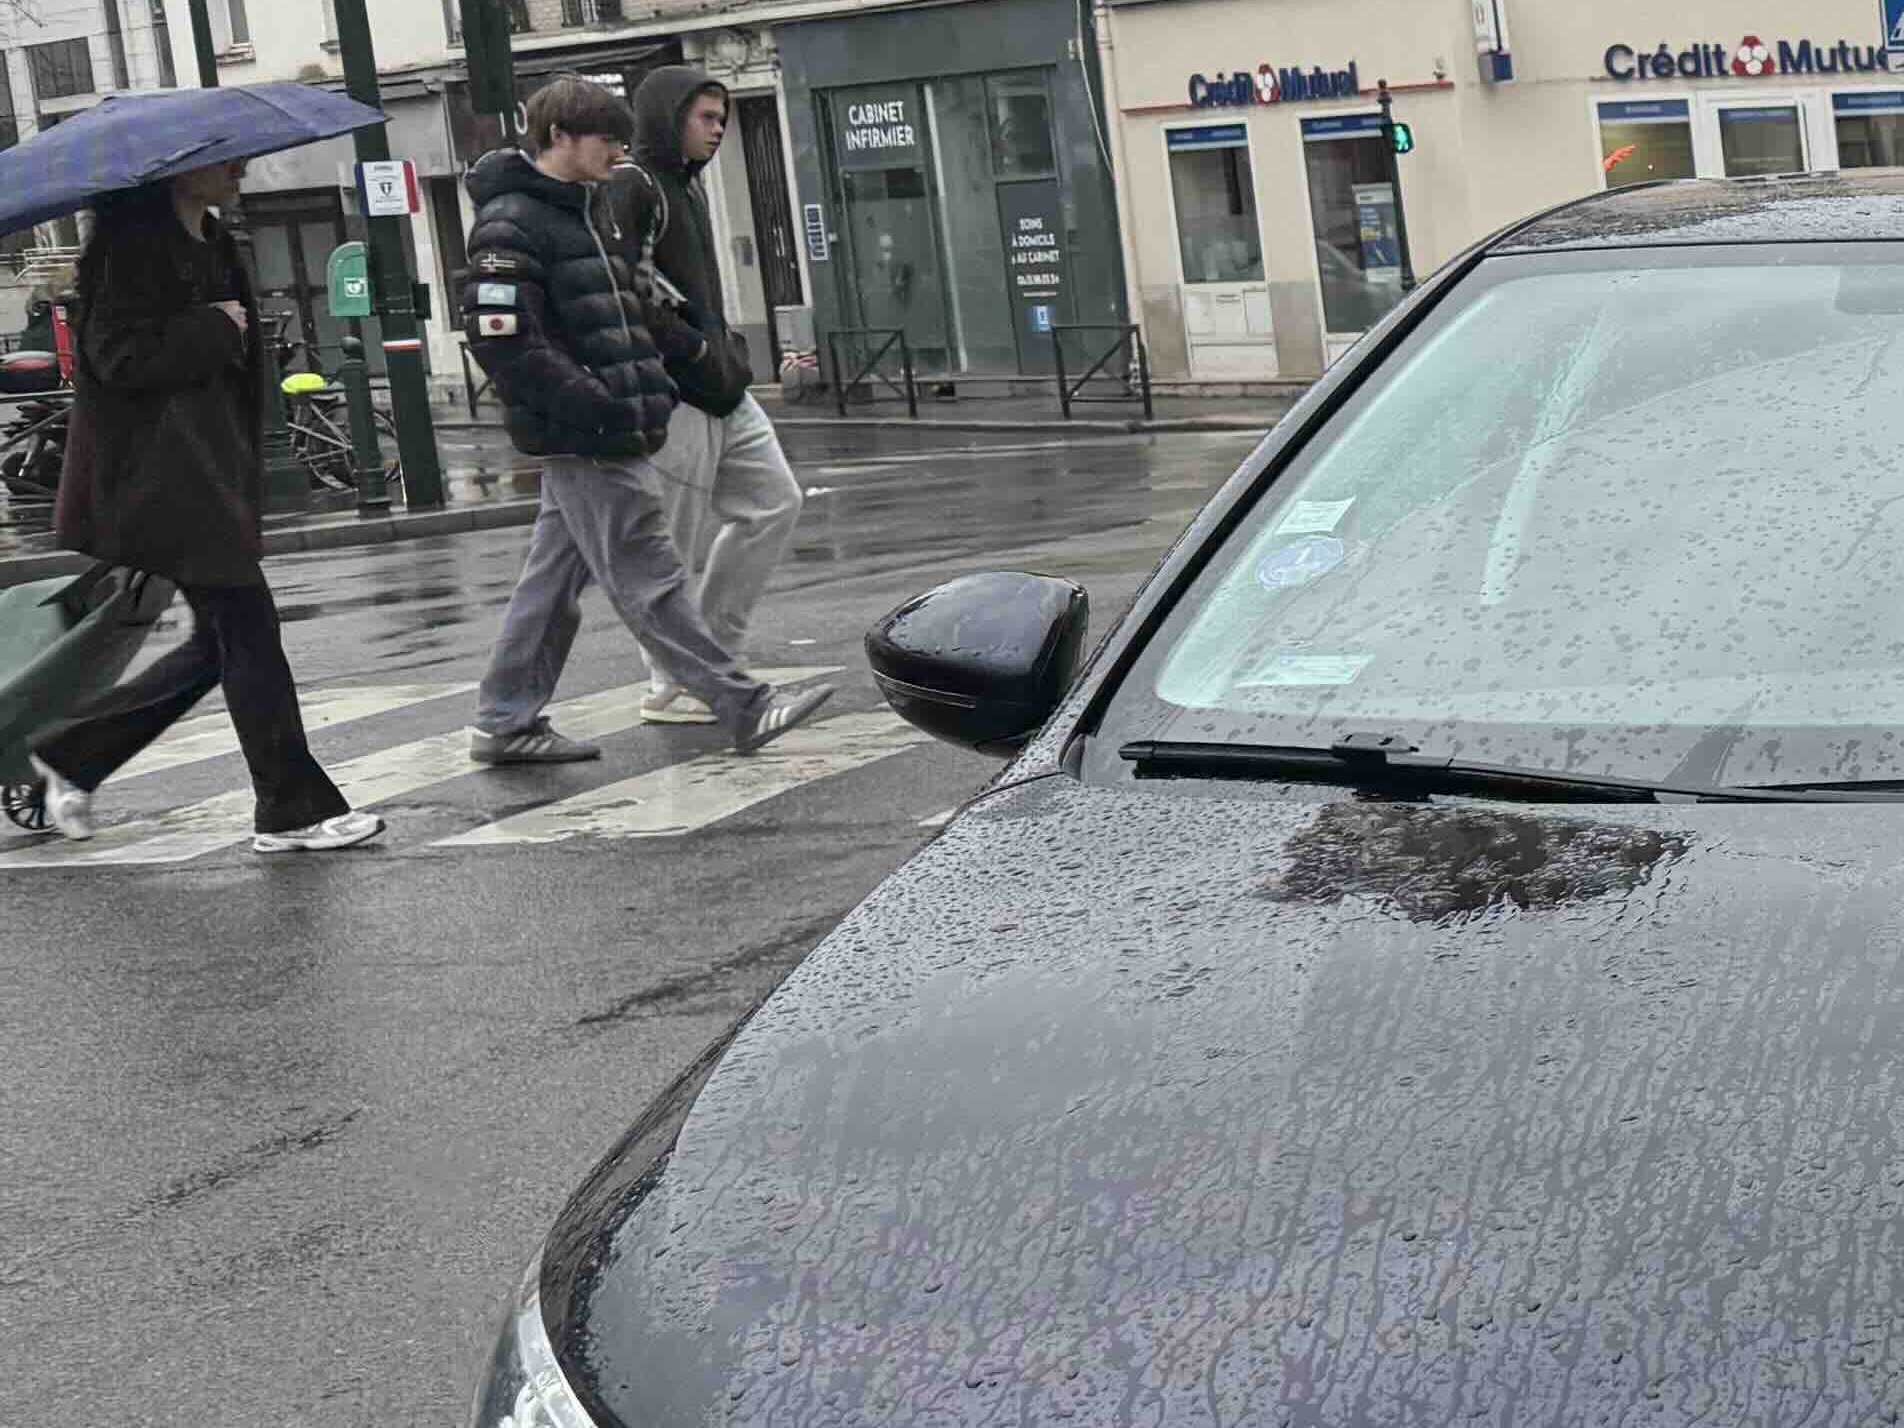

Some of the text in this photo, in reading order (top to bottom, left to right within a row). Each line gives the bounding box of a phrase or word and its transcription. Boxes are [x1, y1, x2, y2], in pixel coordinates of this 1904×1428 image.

[1603, 37, 1890, 80] Crédit Mutue
[1189, 60, 1361, 109] Crédit Mutuel
[848, 100, 905, 125] CABINET
[845, 124, 915, 151] INFIRMIER
